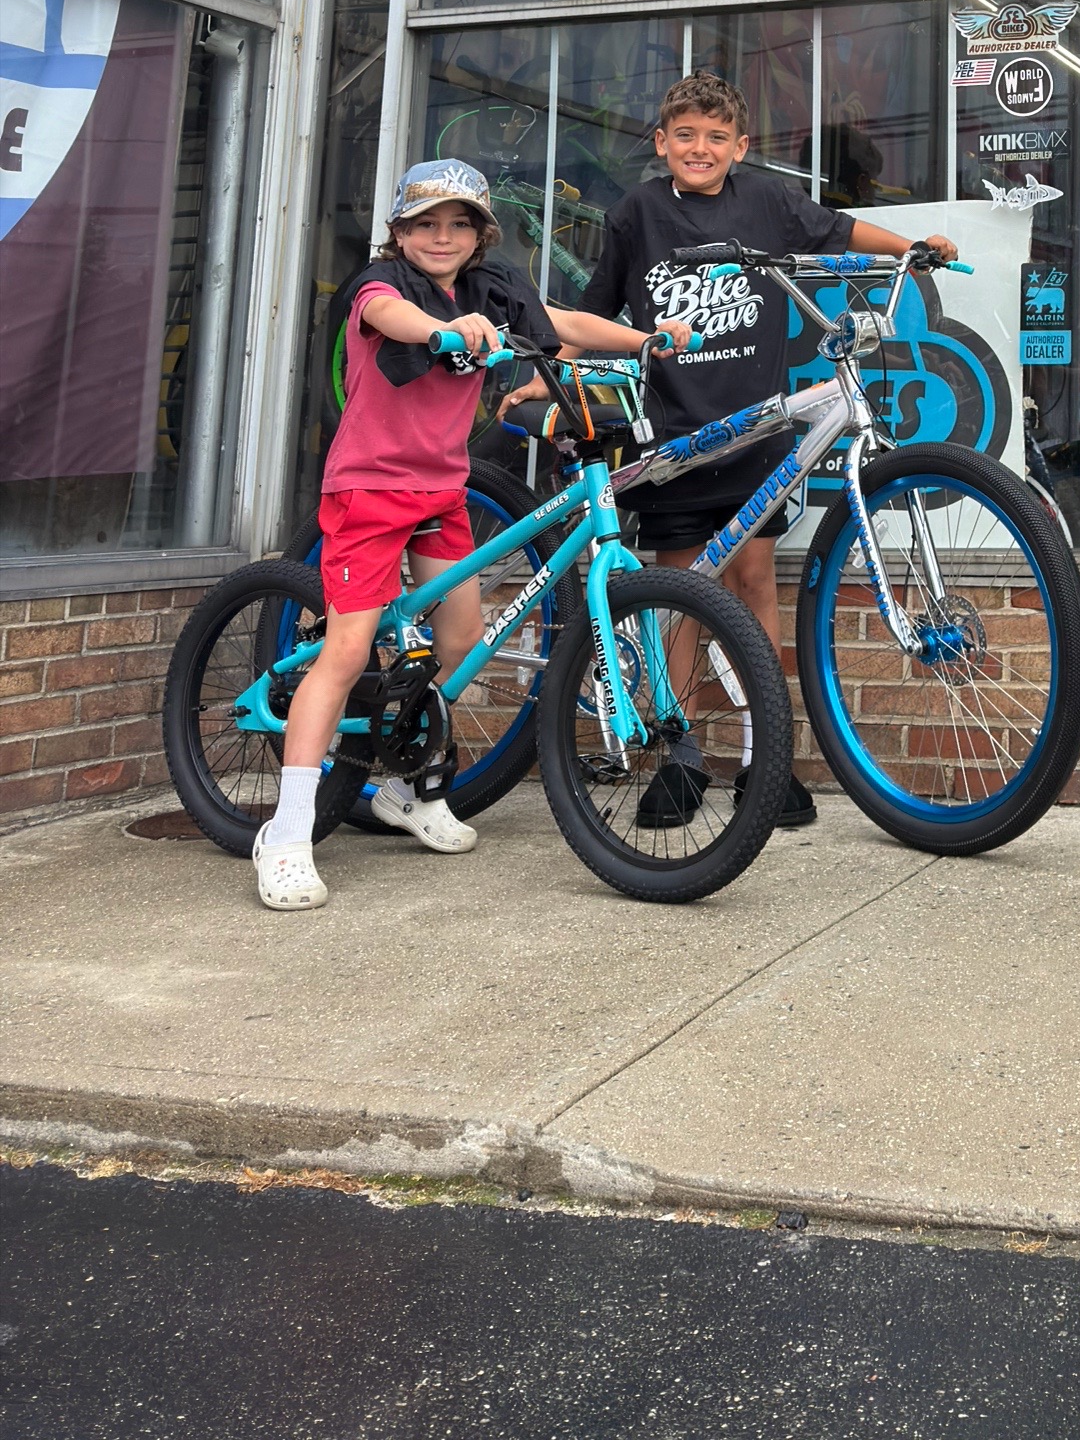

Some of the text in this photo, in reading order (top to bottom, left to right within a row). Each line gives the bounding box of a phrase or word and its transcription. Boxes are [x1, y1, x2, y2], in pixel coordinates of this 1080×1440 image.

[1003, 10, 1025, 24] SE
[1001, 24, 1025, 33] BIKES
[968, 40, 1057, 53] AUTHORIZED DEALER
[956, 61, 975, 70] KEL
[955, 69, 975, 78] TEC
[1004, 68, 1044, 94] WORLD
[1007, 78, 1044, 105] FAMOUS
[994, 150, 1053, 162] AUTHORIZED DEALER
[652, 274, 751, 317] Bike
[1026, 314, 1065, 322] MARIN
[1026, 335, 1065, 344] AUTHORIZED
[677, 345, 756, 365] COMMACK, NY
[1025, 345, 1065, 359] DEALER
[534, 492, 570, 521] SE BIKES
[482, 564, 554, 648] BASHER
[590, 617, 618, 717] LANDING GEAR
